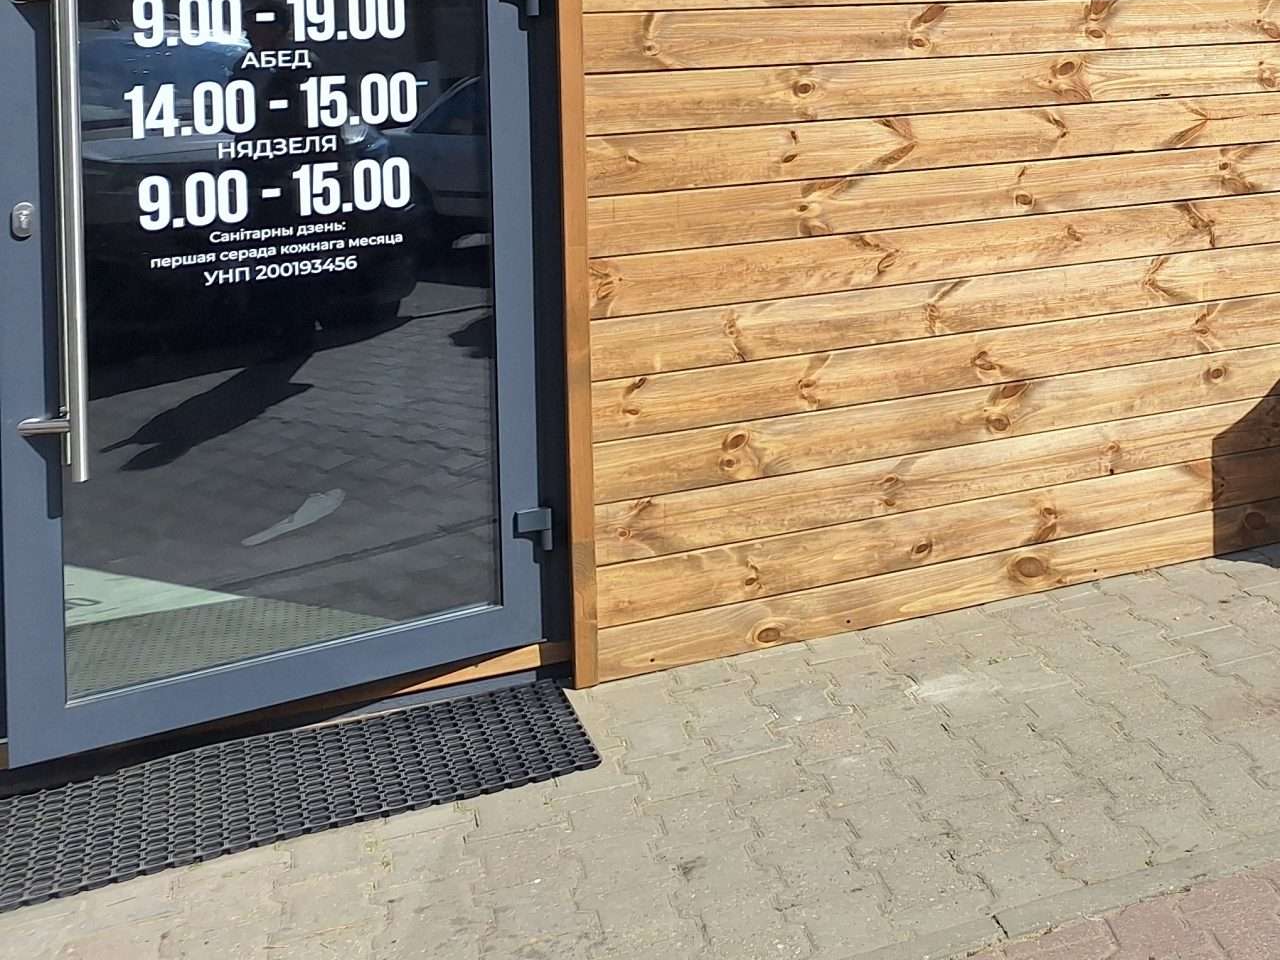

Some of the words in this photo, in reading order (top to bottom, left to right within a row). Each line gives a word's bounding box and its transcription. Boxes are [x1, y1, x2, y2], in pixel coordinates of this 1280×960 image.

[241, 50, 312, 68] АБЕД
[124, 80, 256, 139] 14.00
[300, 72, 417, 128] 15.00
[218, 135, 336, 160] НЯДЗЕЛЯ
[138, 170, 248, 230] 9.00
[293, 157, 410, 216] 15.00
[209, 226, 293, 243] Санітарны
[297, 221, 346, 236] дзень:
[150, 253, 216, 269] першая
[220, 246, 277, 262] серада
[281, 239, 345, 254] кожнага
[348, 233, 403, 248] месяца
[204, 267, 250, 287] УНП
[255, 256, 358, 280] 200193456
